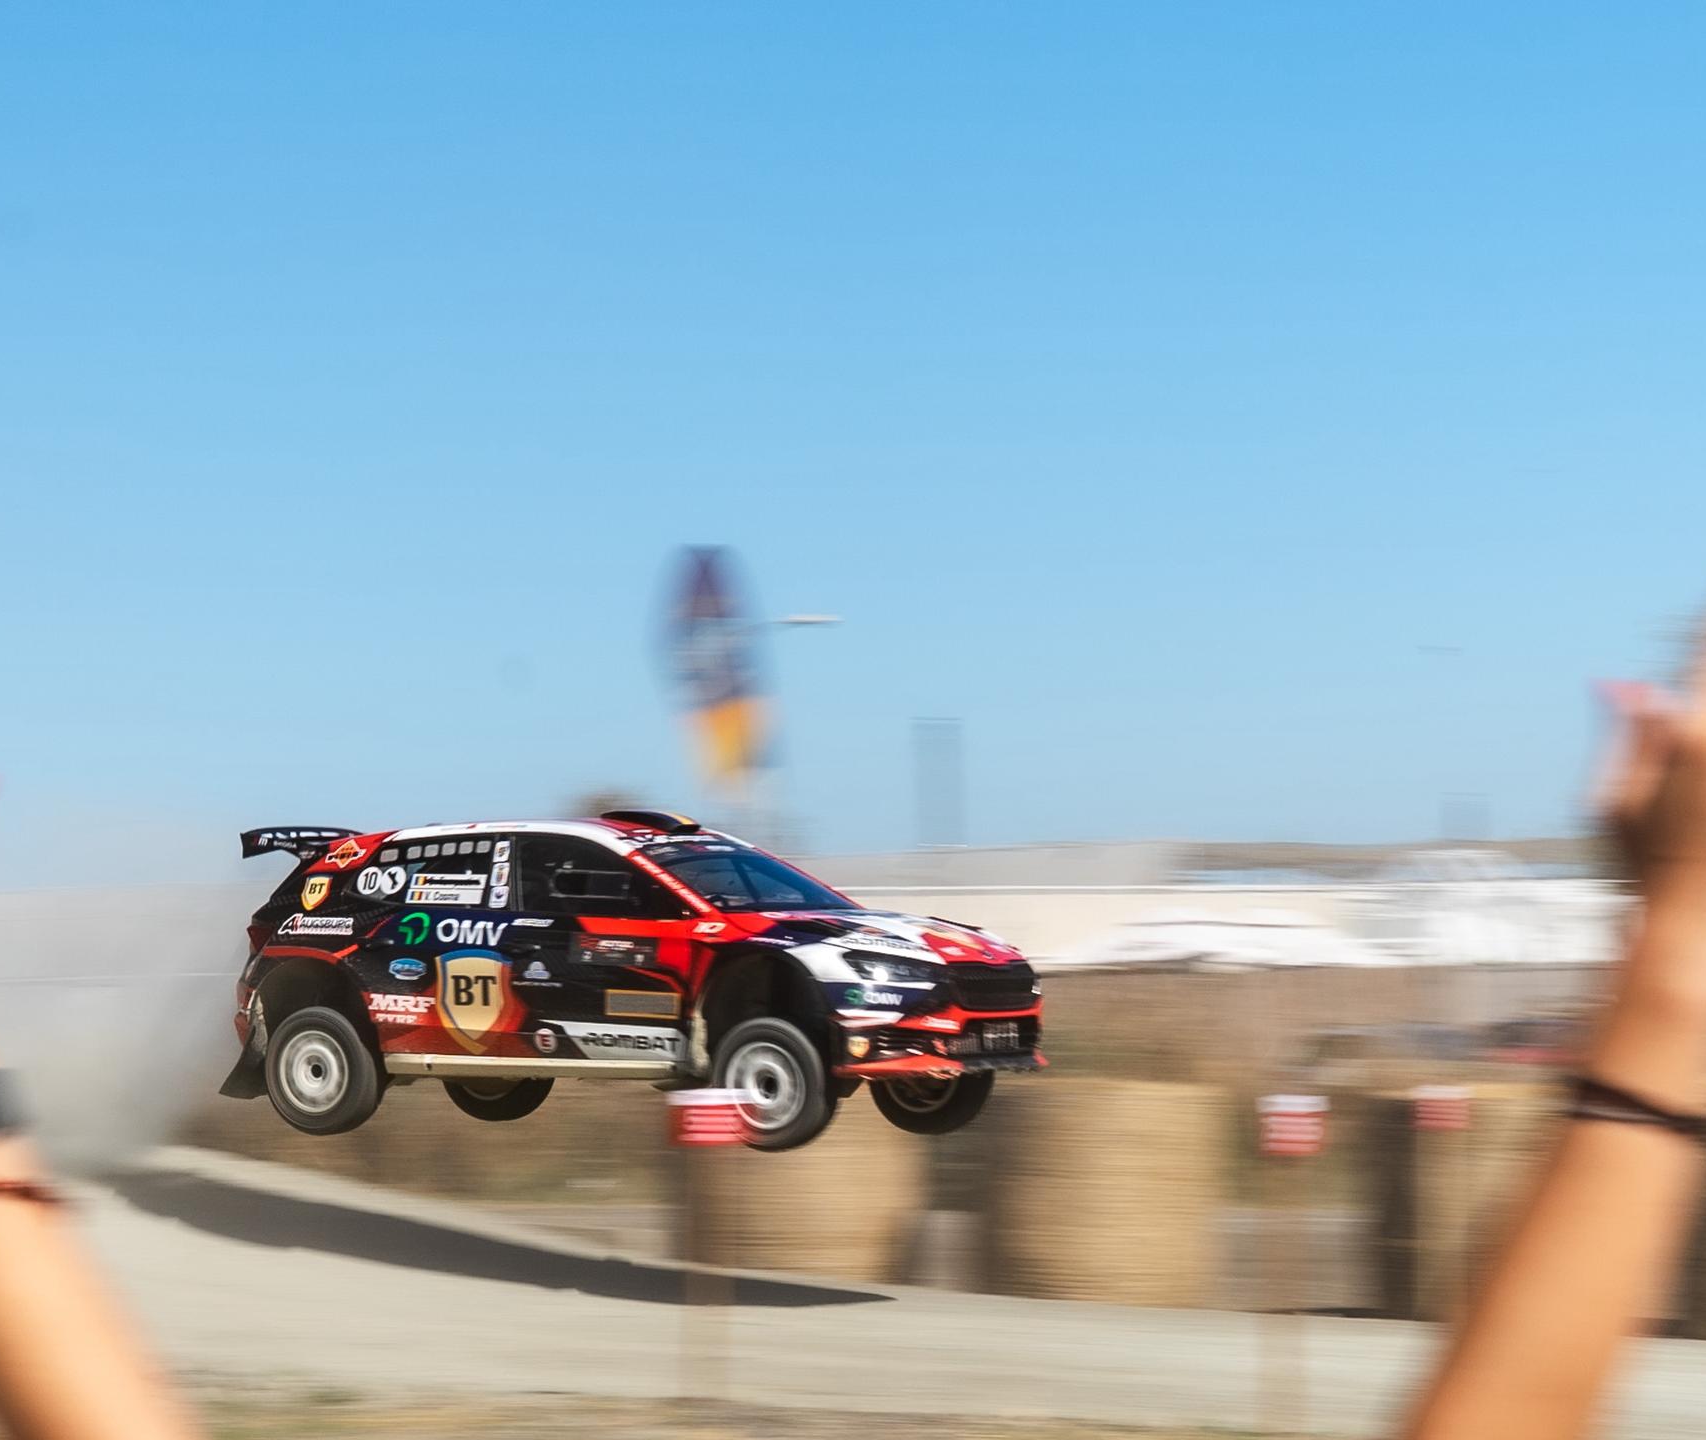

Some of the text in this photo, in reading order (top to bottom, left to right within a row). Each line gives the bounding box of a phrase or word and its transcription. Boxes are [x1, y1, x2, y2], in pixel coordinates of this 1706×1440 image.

[308, 883, 325, 895] BT
[362, 871, 378, 891] 10
[436, 918, 509, 947] OMV
[450, 975, 497, 1006] BT
[368, 993, 437, 1013] MRF
[581, 1032, 680, 1052] ROMBAT
